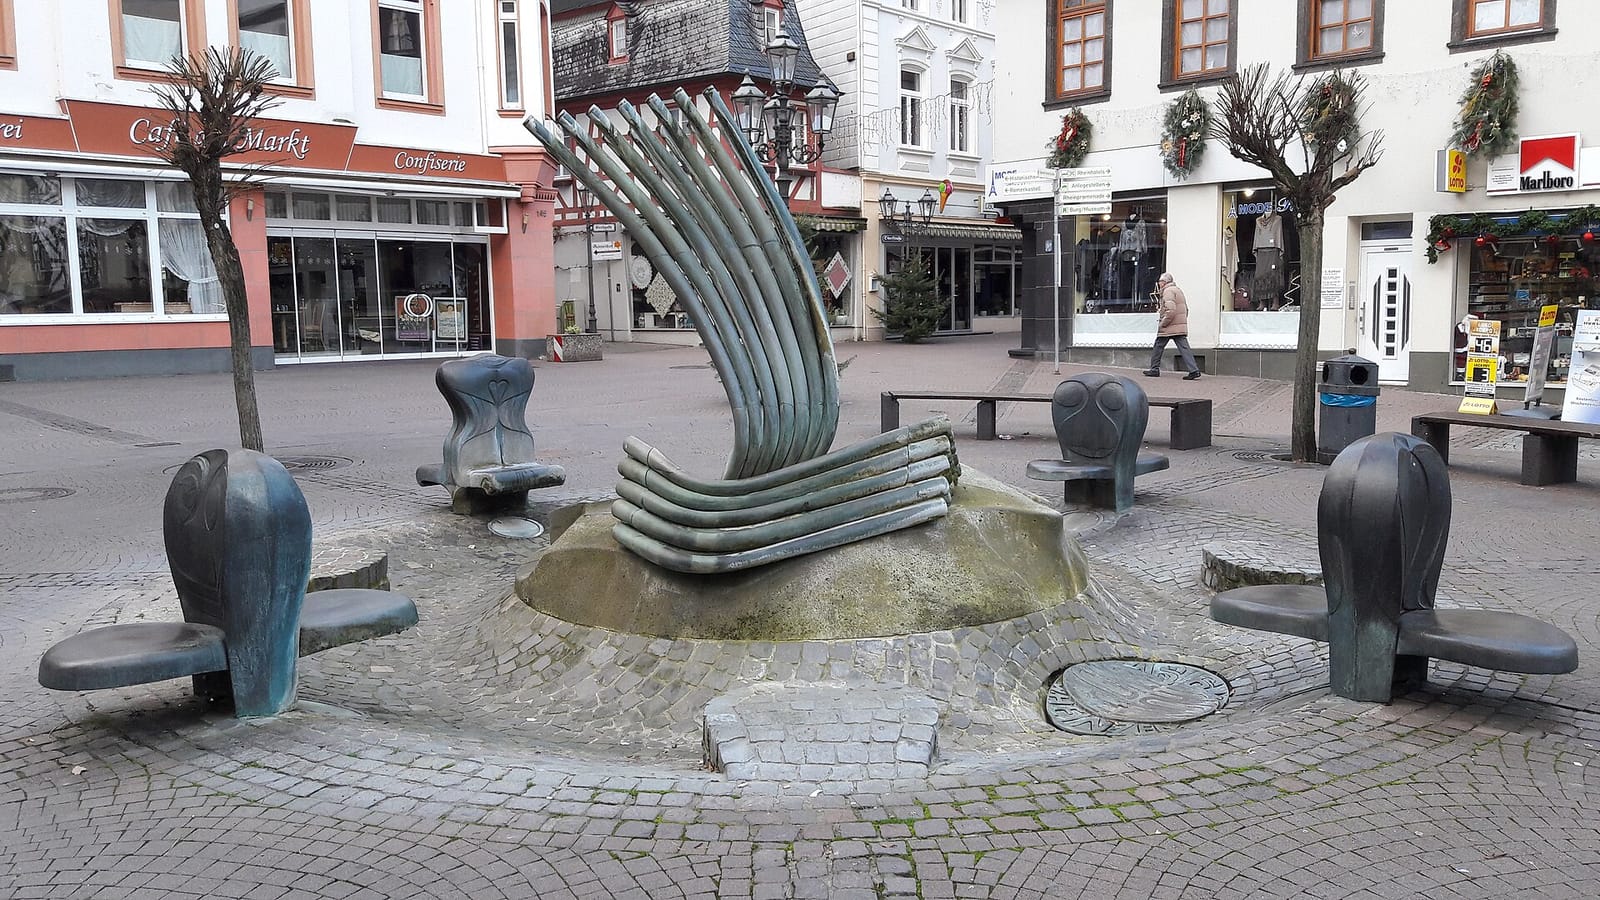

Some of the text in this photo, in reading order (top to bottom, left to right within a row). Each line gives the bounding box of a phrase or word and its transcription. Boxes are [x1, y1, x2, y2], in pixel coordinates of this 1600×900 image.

[236, 127, 311, 160] Markt
[394, 151, 466, 175] Confiserie
[1449, 177, 1464, 188] LOTTO
[1519, 170, 1574, 191] Marlboro
[1238, 202, 1272, 215] MODE
[1475, 338, 1491, 353] 46
[1481, 368, 1489, 382] 3
